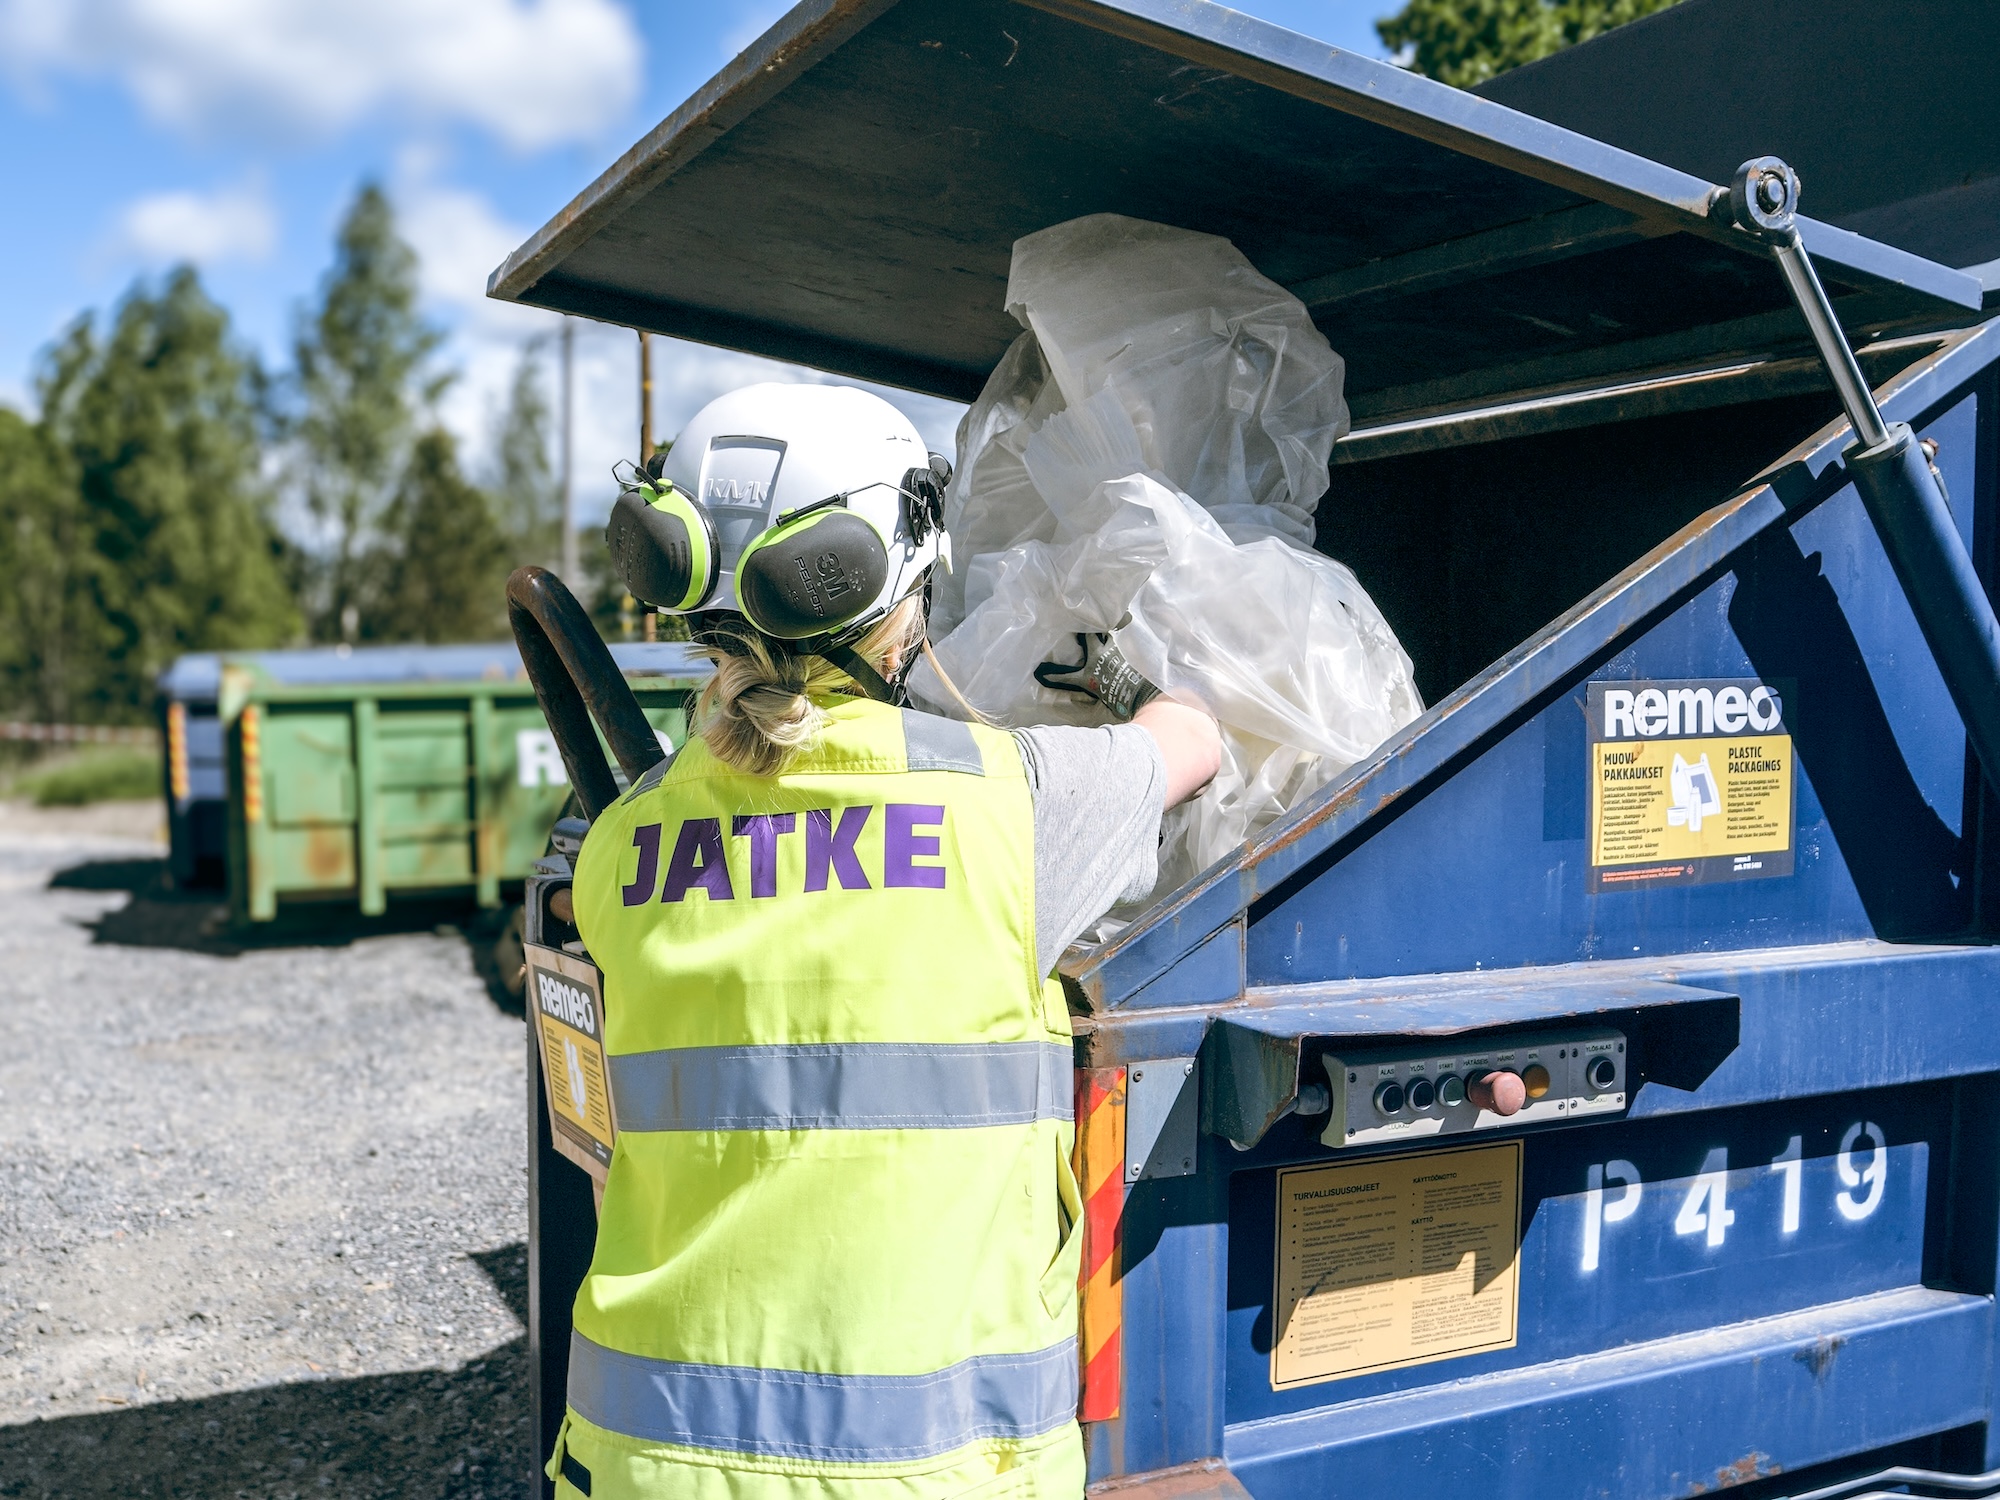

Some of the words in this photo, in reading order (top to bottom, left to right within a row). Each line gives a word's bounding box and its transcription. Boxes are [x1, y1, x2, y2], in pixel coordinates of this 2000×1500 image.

[815, 552, 850, 600] 3M
[793, 556, 825, 618] PELTOR
[1604, 685, 1783, 737] Remeo
[1728, 746, 1762, 759] PLASTIC
[1604, 766, 1664, 781] PAKKAUKSET
[1728, 760, 1781, 774] PACKAGINGS
[622, 803, 946, 907] JATKE
[538, 972, 594, 1035] Remeo
[1412, 1172, 1458, 1184] KÄYTTÖÖNOTTO
[1293, 1182, 1380, 1200] TURVALLISUUSOHJEET
[1411, 1216, 1434, 1225] KÄYTTÖ
